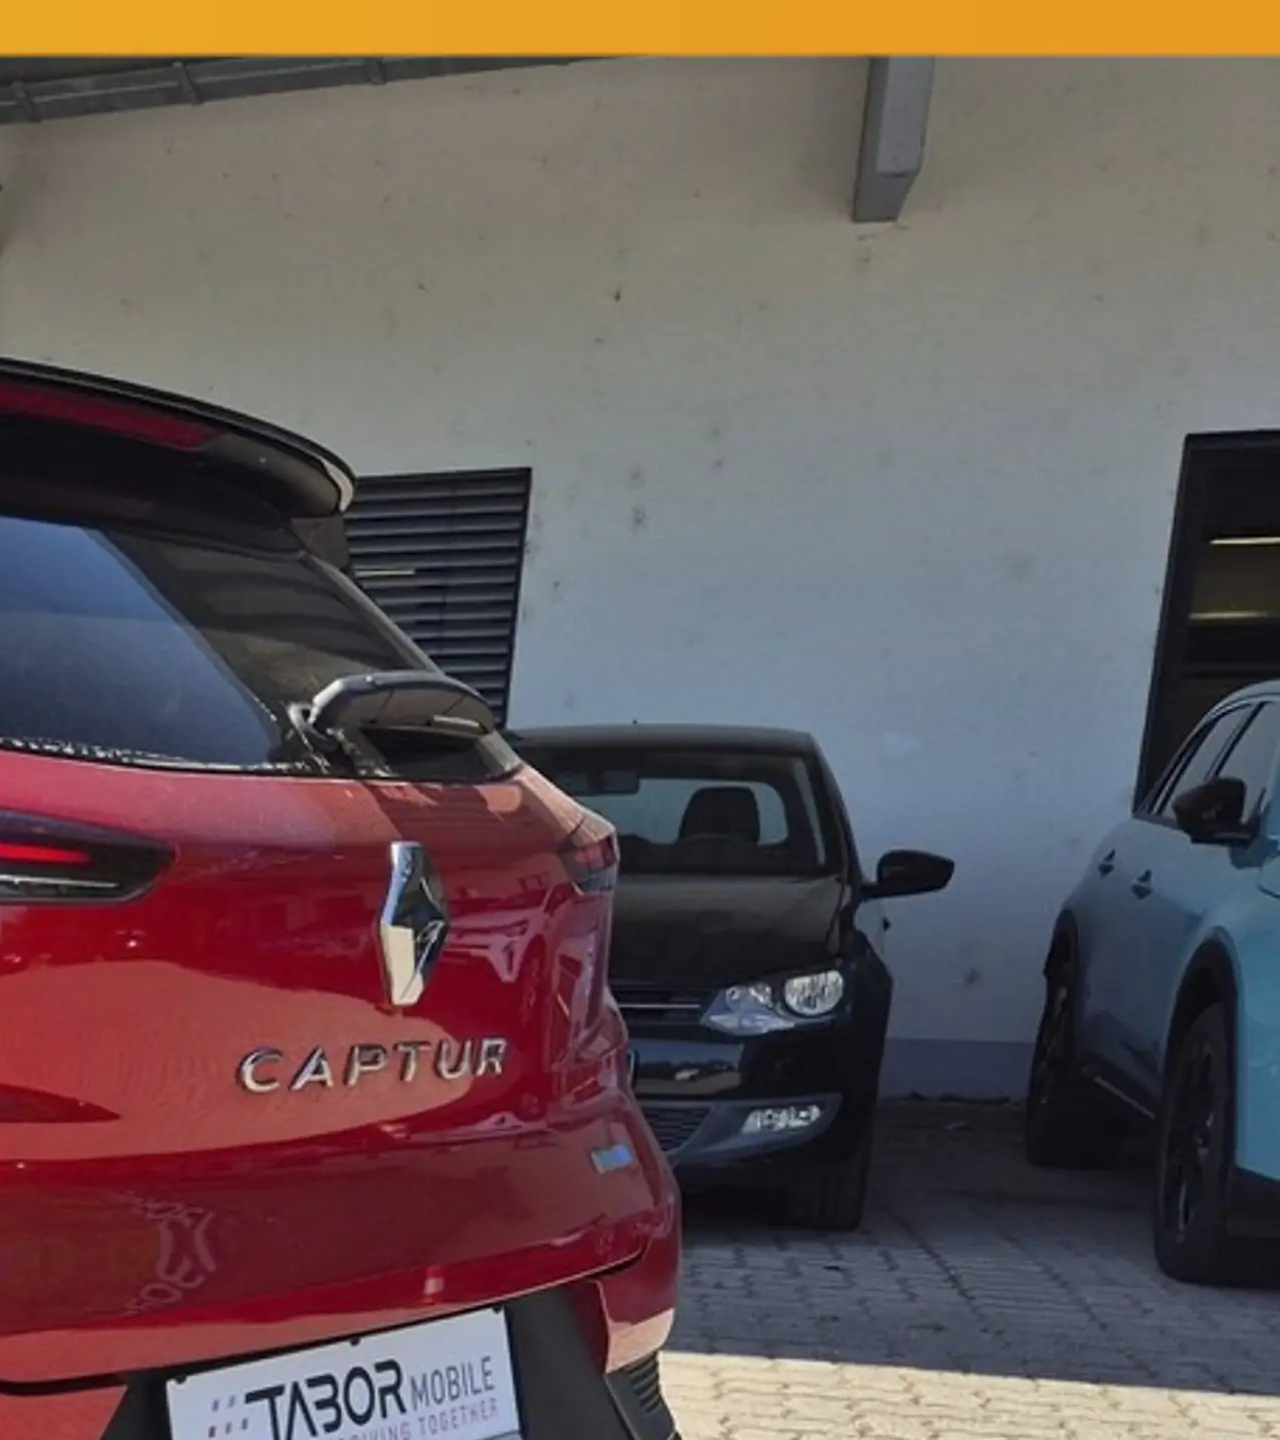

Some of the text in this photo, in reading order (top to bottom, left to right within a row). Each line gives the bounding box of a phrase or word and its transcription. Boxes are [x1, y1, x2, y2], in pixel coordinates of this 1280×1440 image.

[235, 1036, 508, 1094] CAPTUR
[409, 1356, 495, 1411] MOBILE
[416, 1398, 500, 1436] TOGETHER
